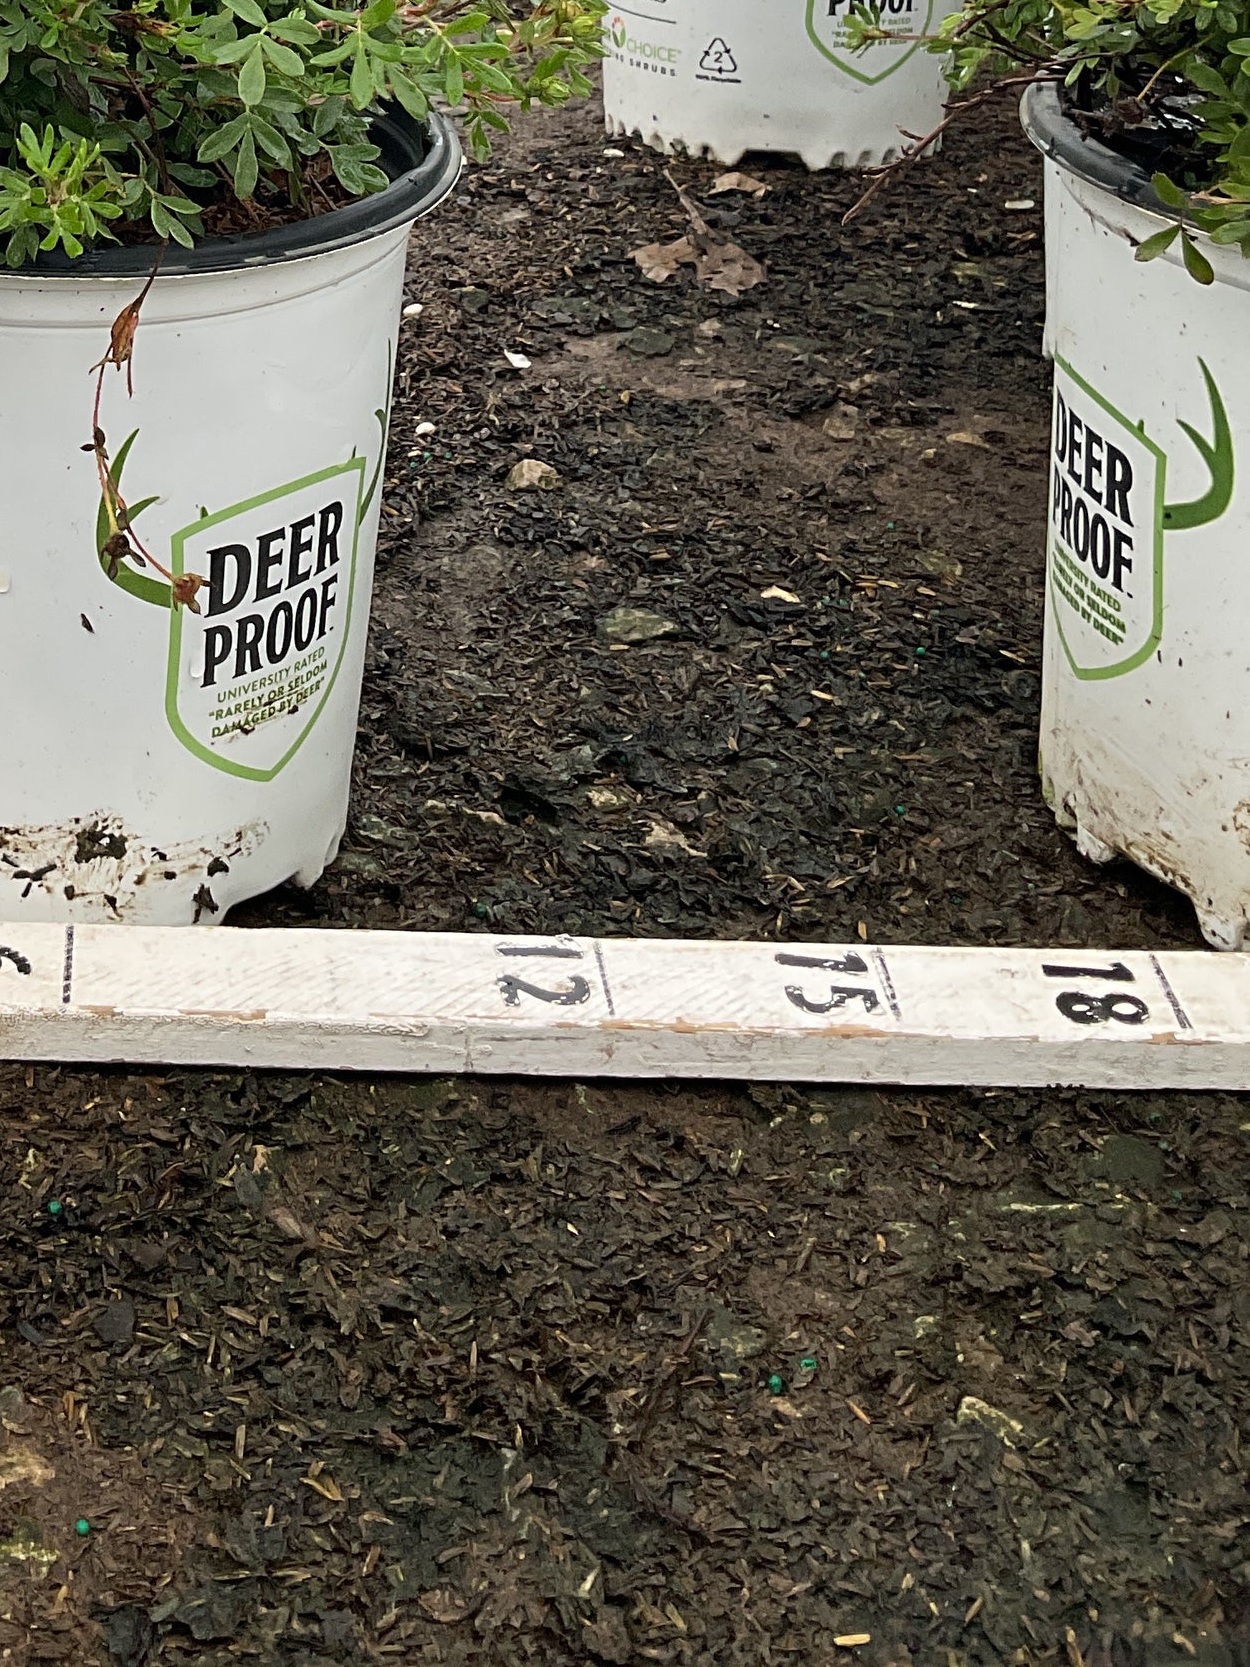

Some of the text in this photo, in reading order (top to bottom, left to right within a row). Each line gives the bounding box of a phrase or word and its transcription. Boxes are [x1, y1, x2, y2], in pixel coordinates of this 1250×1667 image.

[714, 51, 723, 64] 2
[1055, 384, 1134, 528] DEER
[1053, 460, 1134, 593] PROOF
[204, 501, 344, 618] DEER
[1090, 579, 1121, 613] RATED
[200, 573, 338, 688] PROOF
[217, 646, 325, 703] UNIVERSITY RATED
[267, 685, 285, 701] OR
[288, 659, 328, 693] SELDOM
[211, 706, 276, 738] DAMAGED
[277, 696, 293, 713] BY
[494, 934, 590, 1008] 12
[774, 950, 879, 1015] 15
[1040, 961, 1150, 1026] 18
